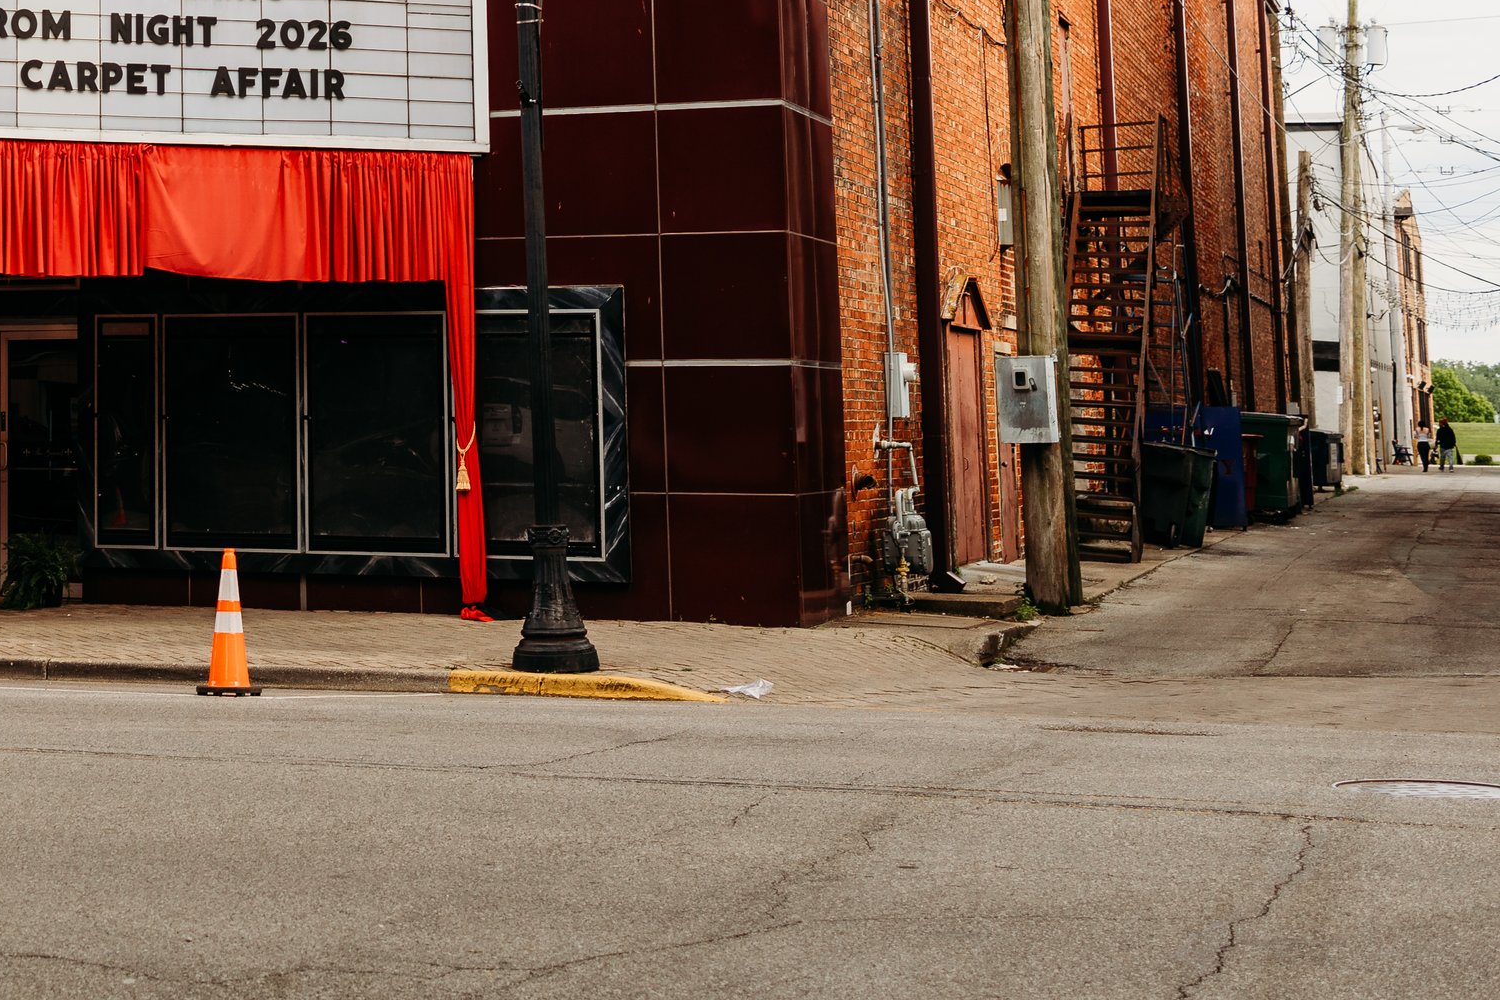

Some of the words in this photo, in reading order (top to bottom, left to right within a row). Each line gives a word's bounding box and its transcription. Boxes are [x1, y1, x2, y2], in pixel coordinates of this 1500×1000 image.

[110, 13, 217, 47] NIGHT
[256, 19, 353, 50] 2026
[20, 59, 172, 95] CARPET
[211, 66, 345, 101] AFFAIR
